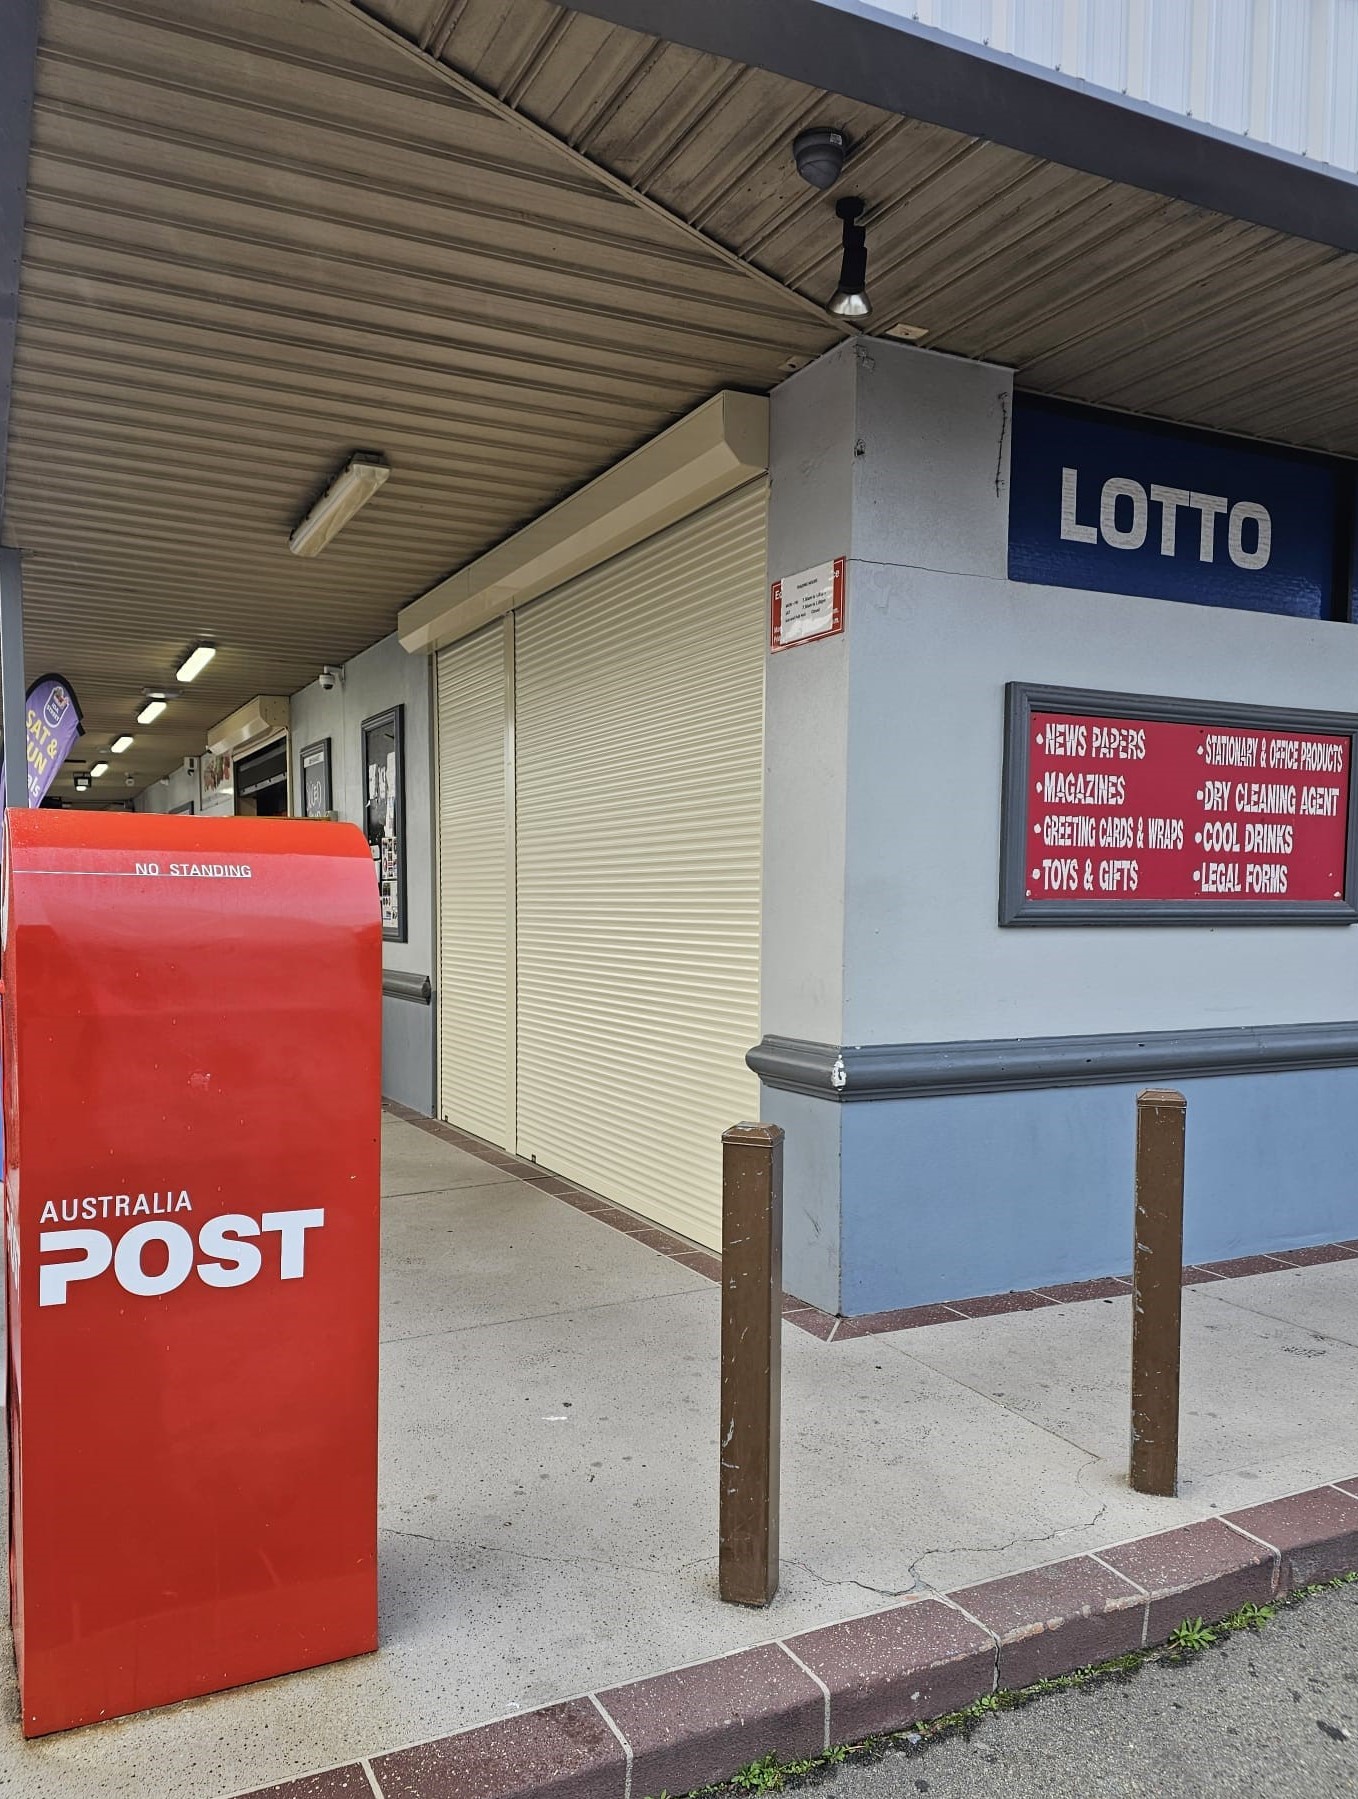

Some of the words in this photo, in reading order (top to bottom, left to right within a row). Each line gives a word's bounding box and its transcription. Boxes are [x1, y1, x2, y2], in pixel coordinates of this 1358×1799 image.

[1061, 467, 1271, 569] LOTTO
[26, 710, 51, 743] SAT
[47, 739, 58, 759] &
[1046, 724, 1087, 756] NEWS
[1092, 727, 1145, 759] PAPERS
[1206, 734, 1258, 767] STATIONARY
[1260, 738, 1266, 767] &
[1270, 739, 1299, 769] OFFICE
[1300, 742, 1343, 772] PRODUCTS
[1044, 772, 1125, 805] MAGAZINES
[1205, 781, 1231, 811] DRY
[1236, 783, 1296, 814] CLEANING
[1300, 787, 1339, 816] AGENT
[1044, 815, 1095, 847] GREETING
[1099, 817, 1133, 848] CARDS
[1137, 818, 1144, 848] &
[1149, 818, 1183, 850] WRAPS
[1203, 821, 1240, 852] COOL
[1245, 824, 1293, 854] DRINKS
[135, 863, 159, 876] NO
[169, 863, 251, 877] STANDING
[1043, 859, 1078, 890] TOYS
[1084, 859, 1093, 890] &
[1099, 860, 1138, 891] GIFTS
[1202, 862, 1241, 892] LEGAL
[1246, 864, 1287, 893] FORMS
[40, 1191, 192, 1223] AUSTRALIA
[40, 1208, 324, 1306] POST
